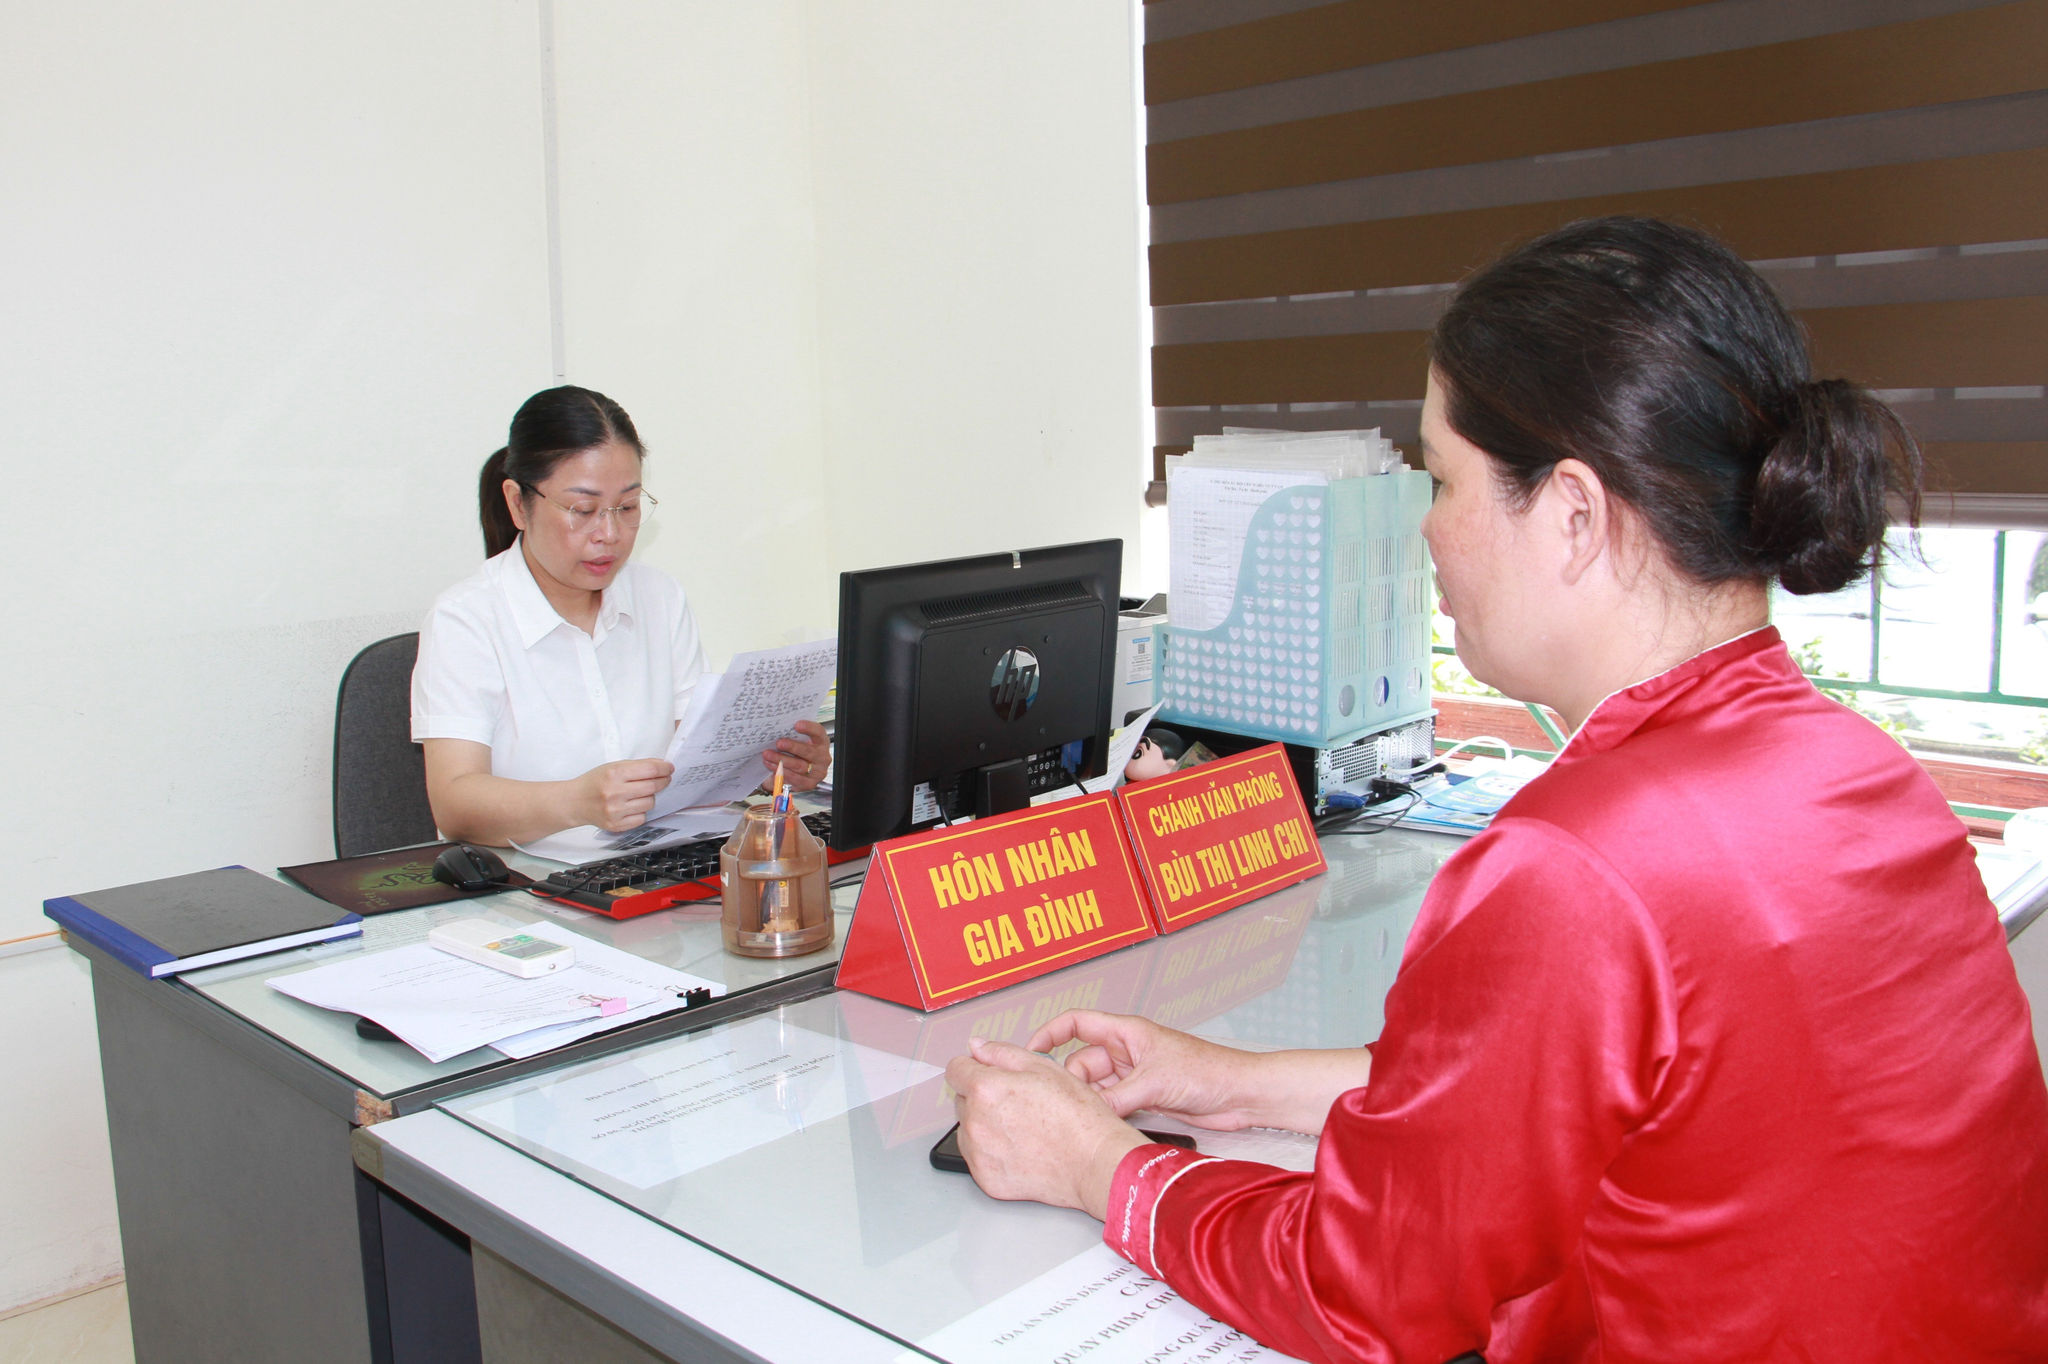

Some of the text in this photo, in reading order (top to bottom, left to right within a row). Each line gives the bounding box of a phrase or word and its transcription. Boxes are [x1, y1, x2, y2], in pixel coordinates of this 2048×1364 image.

[1148, 770, 1284, 837] CHÁNH VĂN PHÒNG
[928, 827, 1097, 909] HÔN NHÂN
[1159, 818, 1309, 902] BÙI THỊ LINH CHI
[962, 889, 1104, 966] GIA ĐÌNH
